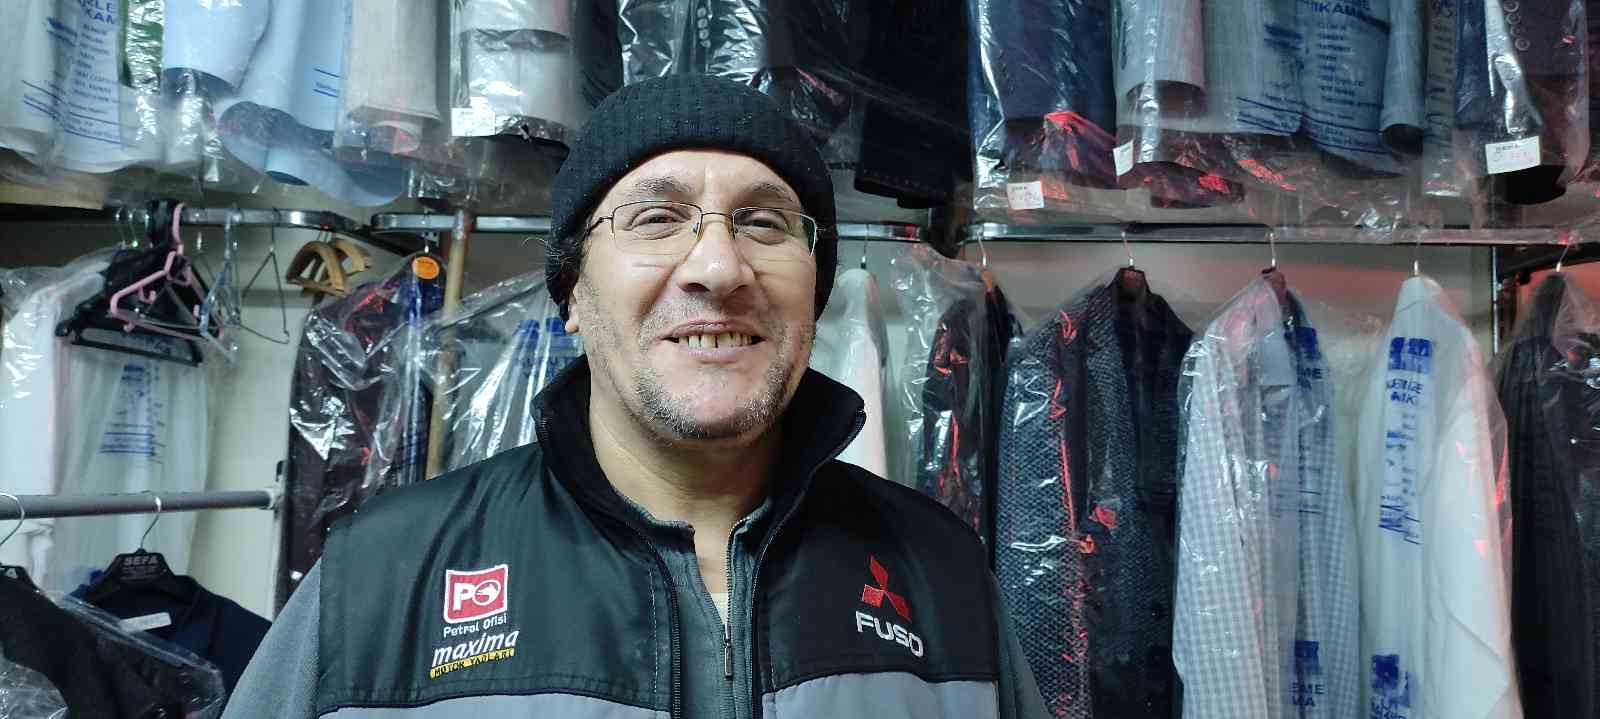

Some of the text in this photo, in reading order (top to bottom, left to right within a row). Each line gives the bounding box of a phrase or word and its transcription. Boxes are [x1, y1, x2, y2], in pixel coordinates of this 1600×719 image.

[124, 555, 158, 566] SEFA
[443, 613, 507, 638] Petrol Ofisi
[855, 610, 924, 657] FUSO
[432, 630, 520, 667] maxima
[434, 660, 466, 677] MOTOR
